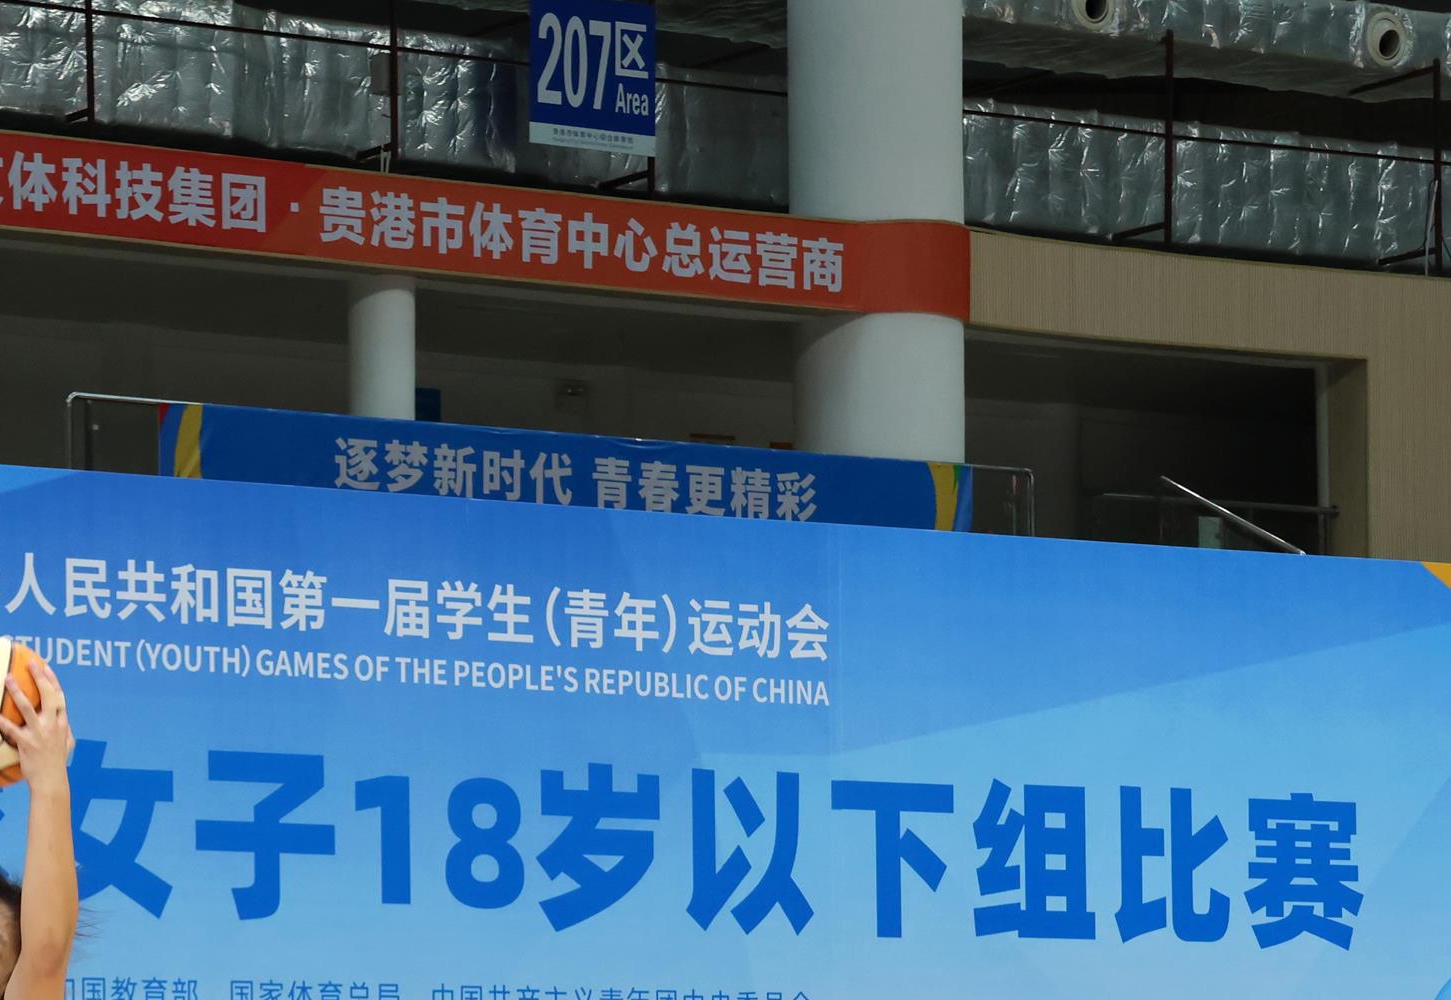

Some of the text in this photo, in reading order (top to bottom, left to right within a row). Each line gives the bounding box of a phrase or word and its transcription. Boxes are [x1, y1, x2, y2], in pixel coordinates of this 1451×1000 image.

[615, 83, 649, 116] Area
[335, 437, 817, 522] 逐梦新时代 青春更精彩
[3, 634, 128, 667] UDENT
[135, 641, 251, 677] (YOUTH)
[256, 648, 348, 680] GAMES
[354, 653, 390, 682] OF
[396, 657, 447, 686] THE
[454, 661, 579, 693] PEOPLE'S
[585, 669, 709, 700] REPUBLIC
[713, 674, 747, 702] OF
[752, 677, 830, 707] CHINA
